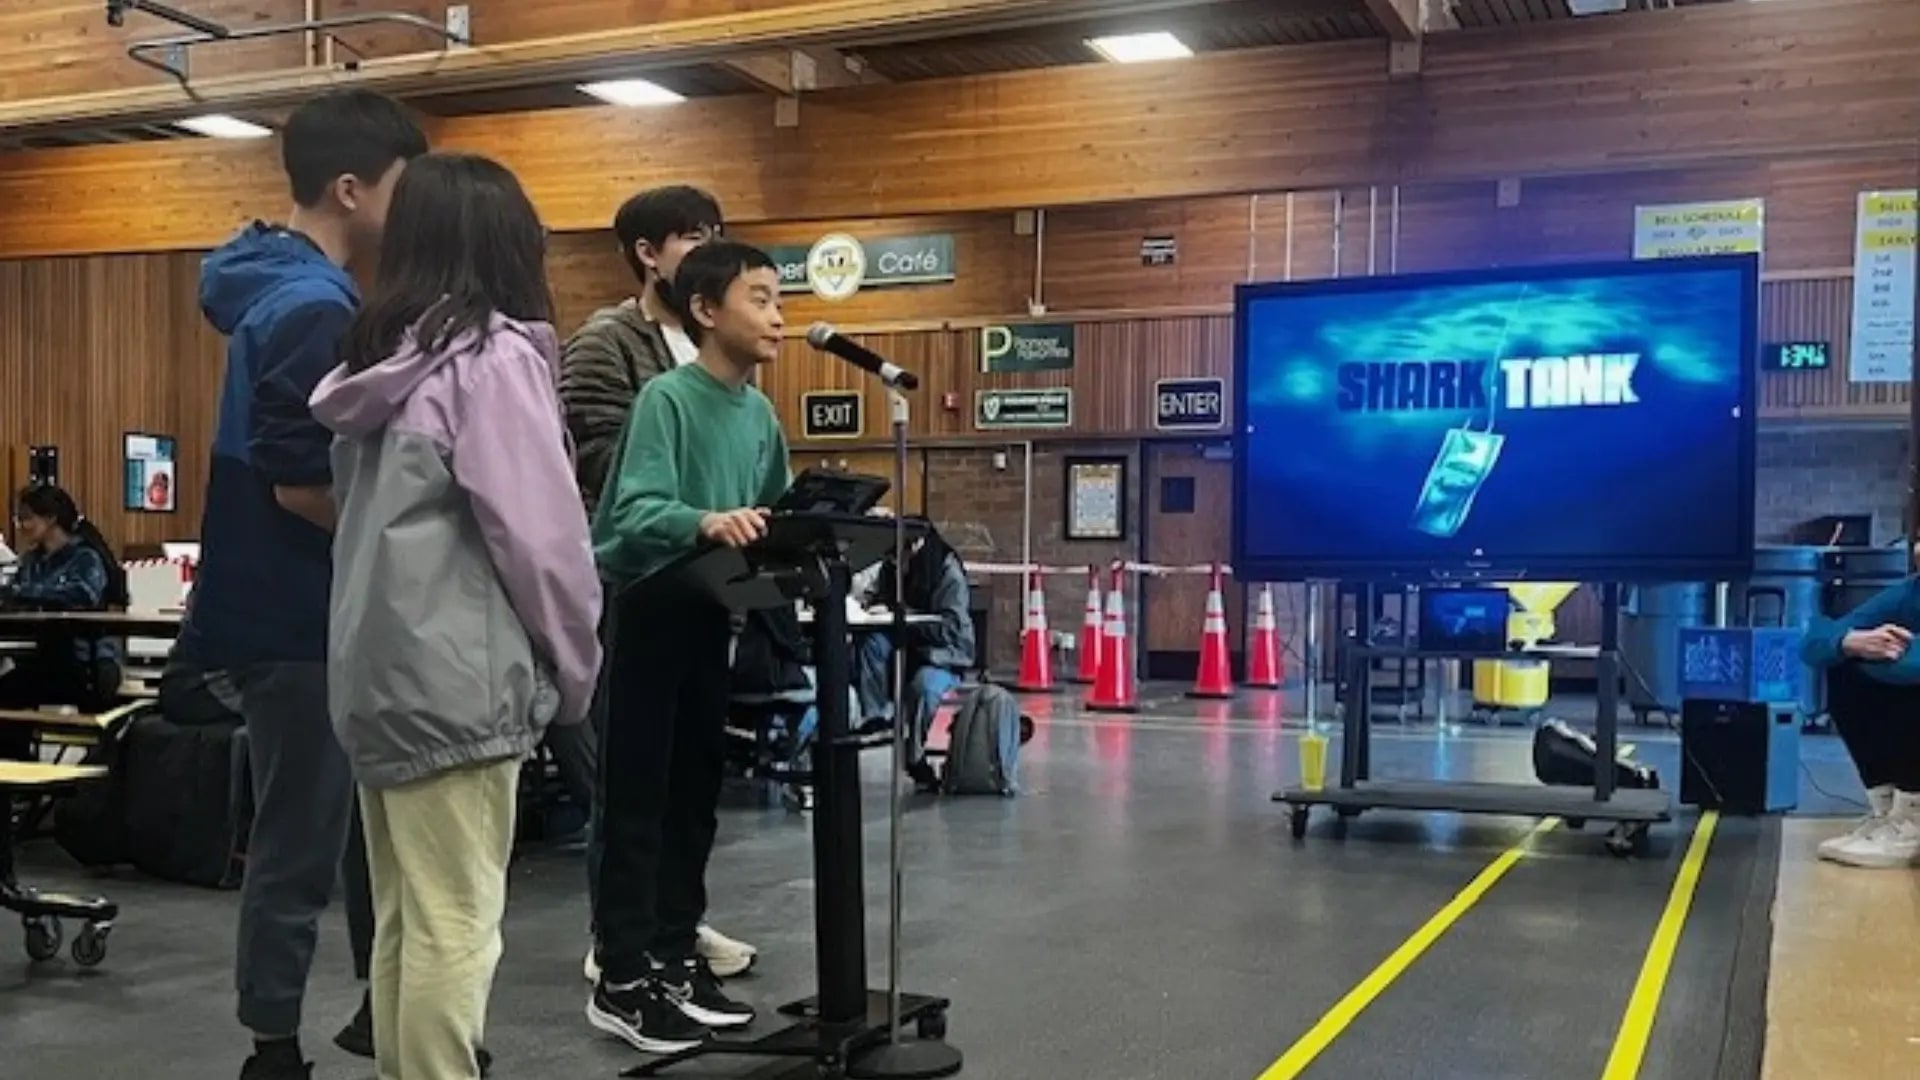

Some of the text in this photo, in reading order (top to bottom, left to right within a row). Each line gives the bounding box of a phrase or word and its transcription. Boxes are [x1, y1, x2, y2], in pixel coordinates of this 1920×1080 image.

[878, 250, 938, 274] Café
[1337, 353, 1641, 412] SHARK TANK
[812, 403, 852, 427] EXIT
[1160, 392, 1219, 417] ENTER
